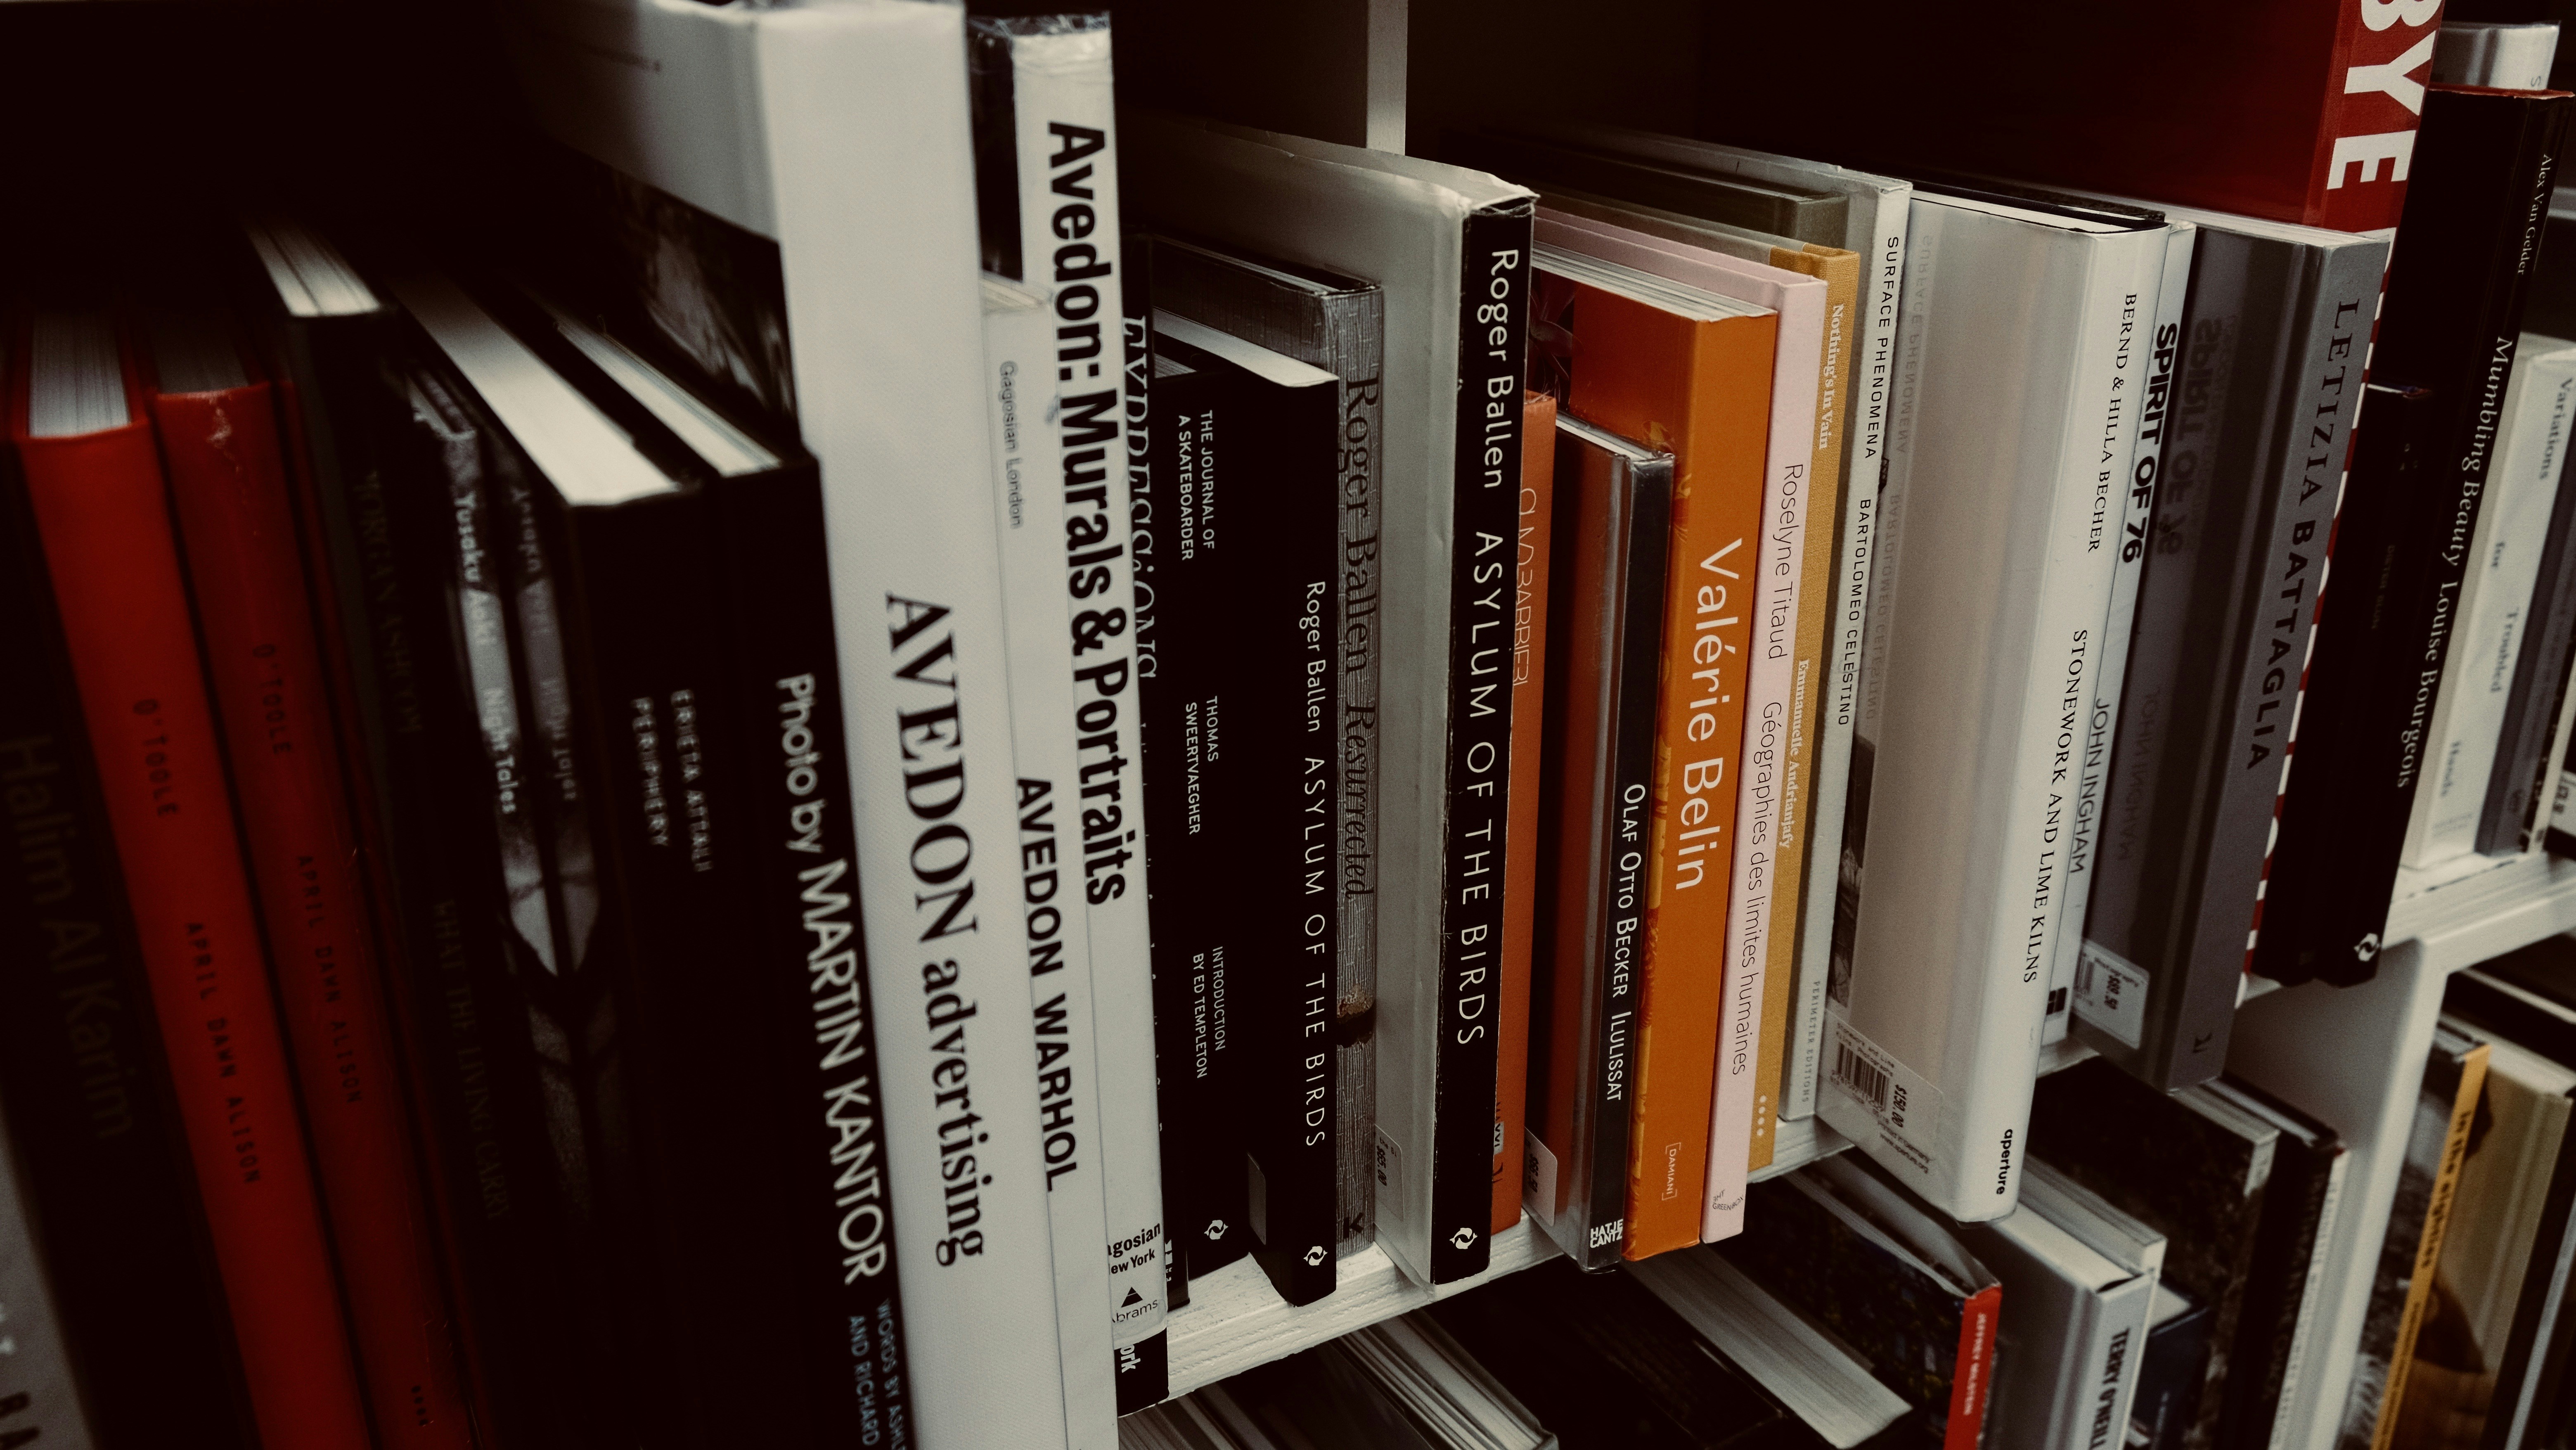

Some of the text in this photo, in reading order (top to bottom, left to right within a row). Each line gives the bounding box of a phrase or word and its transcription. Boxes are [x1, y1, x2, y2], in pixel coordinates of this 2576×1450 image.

[2518, 154, 2552, 275] Alex Van Gelder
[999, 361, 1025, 528] Gagosian London
[1818, 304, 1844, 450] Nothing's In Vain
[2088, 293, 2138, 554] BERND & HILLA BECHER
[2122, 323, 2177, 563] SPIRIT OF 76
[2539, 374, 2573, 480] Variations
[1048, 122, 1136, 905] Avedon: Murals & Portraits
[1179, 415, 1193, 560] A SKATEBOARDER
[1200, 410, 1215, 550] THE JOURNAL OF
[1837, 237, 1898, 725] SURFACE PHENOMENA BARTOLOMEO CELESTINO
[2247, 299, 2360, 770] LETIZIA BATTAGLIA
[2397, 335, 2514, 788] Mumbling Beauty Louise Bourgeois
[2490, 542, 2505, 570] for
[1336, 376, 1379, 900] Roger Ballen Resurrected
[1457, 249, 1519, 1044] Roger Ballen ASYLUM OF THE BIRDS
[2489, 608, 2519, 693] Troubled
[1186, 702, 1200, 834] SWEERTVAEGHER
[1206, 696, 1219, 762] THOMAS
[1676, 538, 1742, 891] Valérie Belin
[1732, 464, 1803, 1075] Roselyne Titaud Géographies des limites humaines
[1779, 661, 1810, 849] Emmanuelle Andrianjafy
[2023, 629, 2088, 983] STONEWORK AND LIME KILNS
[2069, 699, 2111, 874] JOHN INGHAM
[886, 591, 992, 1268] AVEDON advertising
[1298, 582, 1326, 1147] Roger Ballen ASYLUM OF THE BIRDS
[296, 855, 324, 930] APRIL
[328, 1021, 362, 1103] ALISON
[775, 673, 888, 1285] Photo by MARTIN KANTOR
[1016, 778, 1077, 1192] AVEDON WARHOL
[1193, 953, 1207, 1078] BY ED TEMPLETON
[1212, 946, 1225, 1050] INTRODUCTION
[1802, 981, 1820, 1103] PERIMETER EDITIONS
[185, 922, 260, 1183] APRIL DAWN ALISON
[1892, 1085, 1907, 1128] $150.00
[1376, 1146, 1387, 1186] $65.00
[1591, 1219, 1623, 1239] HATJE
[1667, 1149, 1676, 1194] DAMIANI
[1996, 1129, 2013, 1194] aperture
[1108, 1223, 1160, 1258] gosian
[1109, 1249, 1155, 1275] ew York
[1590, 1229, 1622, 1248] CANTZ
[875, 1298, 899, 1373] WORDS
[1112, 1300, 1157, 1323] brams
[1120, 1344, 1141, 1373] ork
[2102, 1328, 2131, 1385] TERRY
[847, 1315, 881, 1446] AND RICHARD
[883, 1375, 901, 1400] BY
